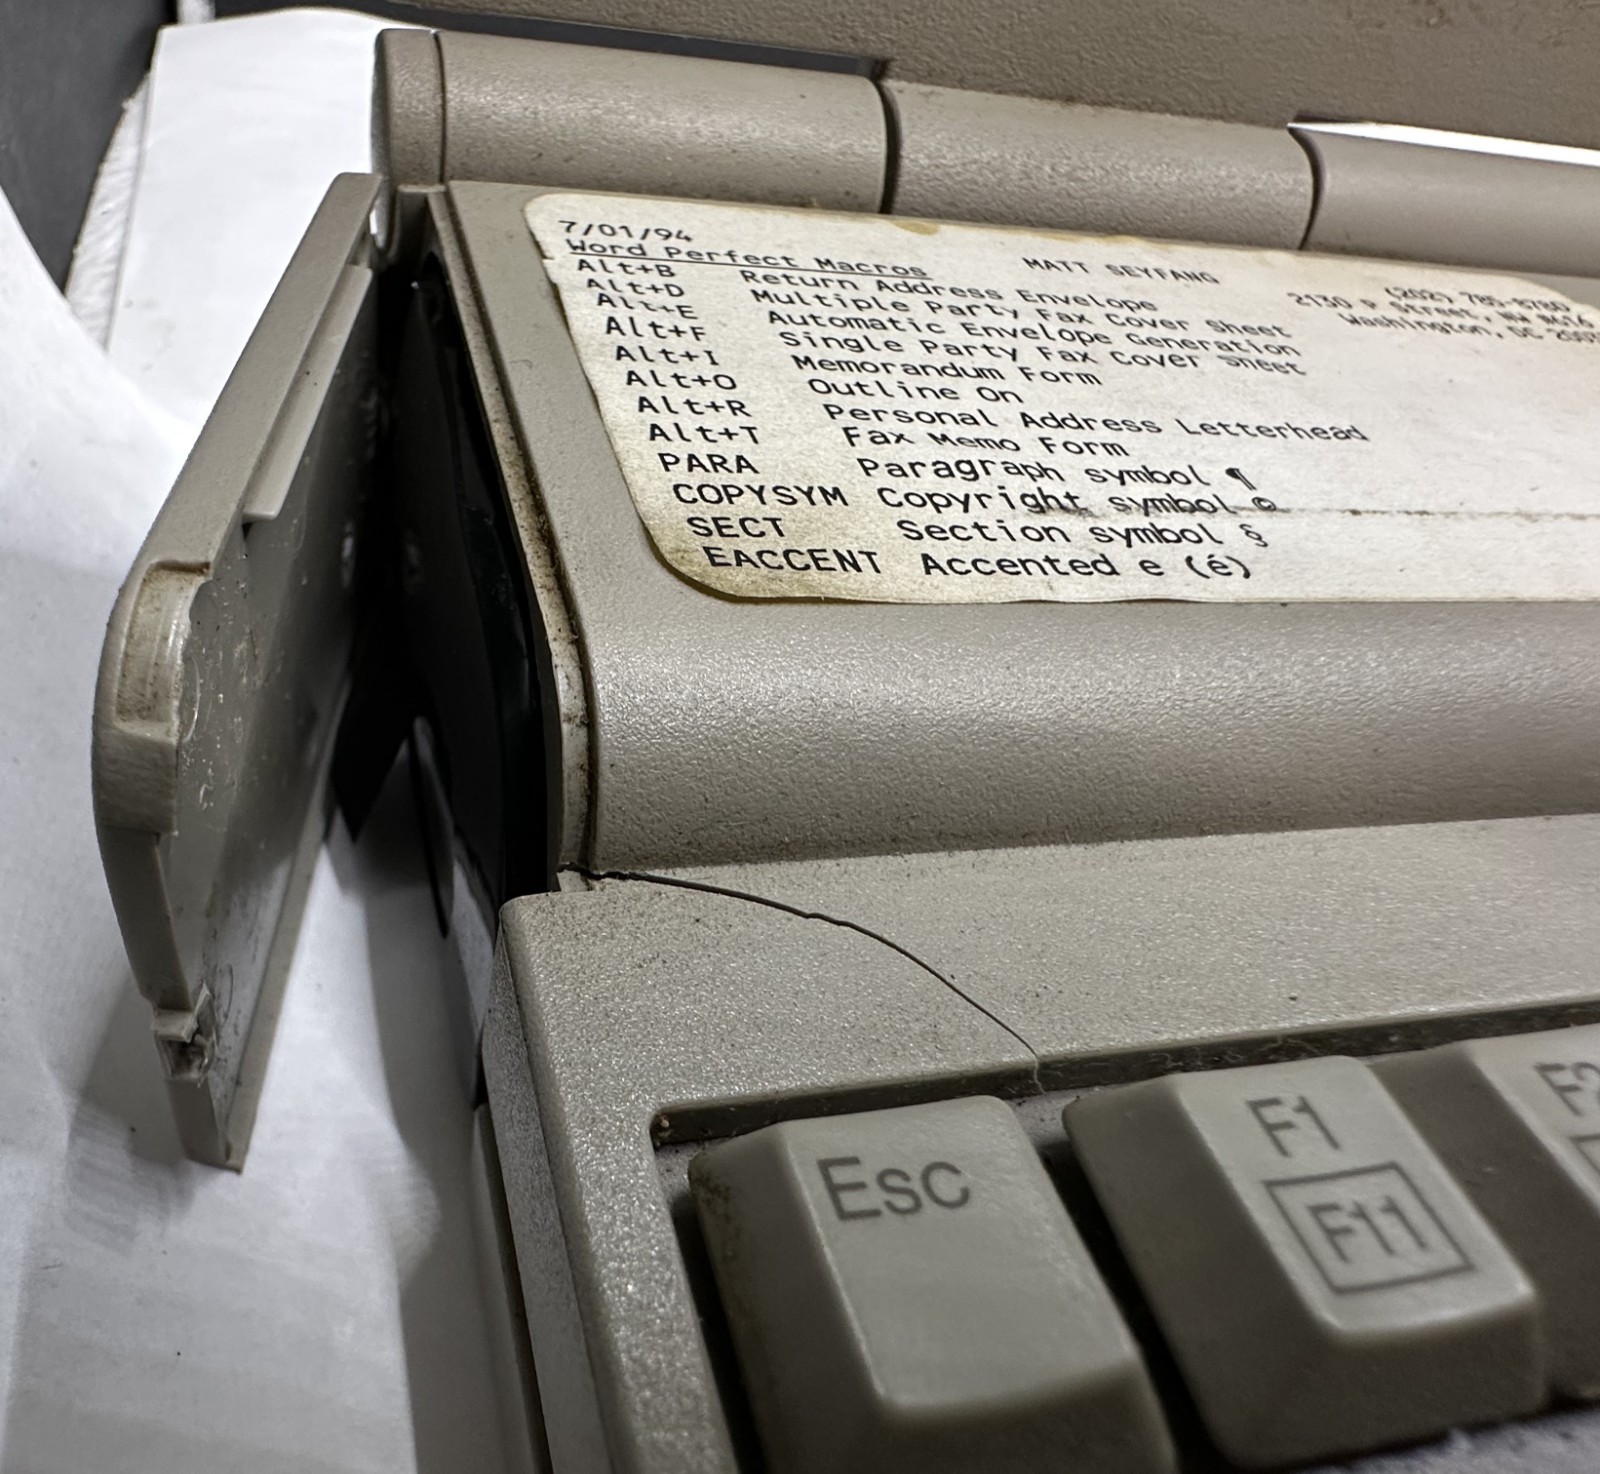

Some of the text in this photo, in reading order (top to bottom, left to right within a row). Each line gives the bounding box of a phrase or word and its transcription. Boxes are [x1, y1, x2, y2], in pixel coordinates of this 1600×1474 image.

[558, 219, 693, 243] 7/01/94
[565, 238, 928, 277] Word Perfect Macros
[1022, 257, 1220, 285] MATT SEYFANG
[577, 258, 1158, 313] Alt+B Return Address Envelope
[1286, 292, 1353, 309] 2130
[586, 277, 1293, 339] Alt+D Multiple Party Fax Cover Sheet
[597, 293, 1302, 357] Alt+E Automatic Envelope Generation
[1337, 312, 1504, 339] Washington,
[1505, 325, 1543, 340] DC
[606, 316, 1307, 376] Alt+F Single Party Fax Cover Sheet
[615, 344, 1103, 386] Alt+I Memorandum Form
[626, 370, 1024, 404] Alt+O Outline On
[637, 395, 1370, 442] Alt+R Personal Address Letterhead
[649, 421, 1130, 457] Alt+T Fax Memo Form
[658, 452, 760, 475] PARA
[857, 457, 1066, 483] Paragraph
[1084, 464, 1211, 488] symbol
[672, 483, 849, 507] COPYSYM
[876, 486, 1090, 515] Copyright
[1108, 493, 1238, 518] symbol
[687, 516, 787, 538] SECT
[896, 518, 1072, 542] Section
[1089, 522, 1224, 549] symbol
[702, 546, 1252, 579] EACCENT Accented e (é)
[1245, 1094, 1343, 1158] F1
[1306, 1195, 1435, 1265] F11
